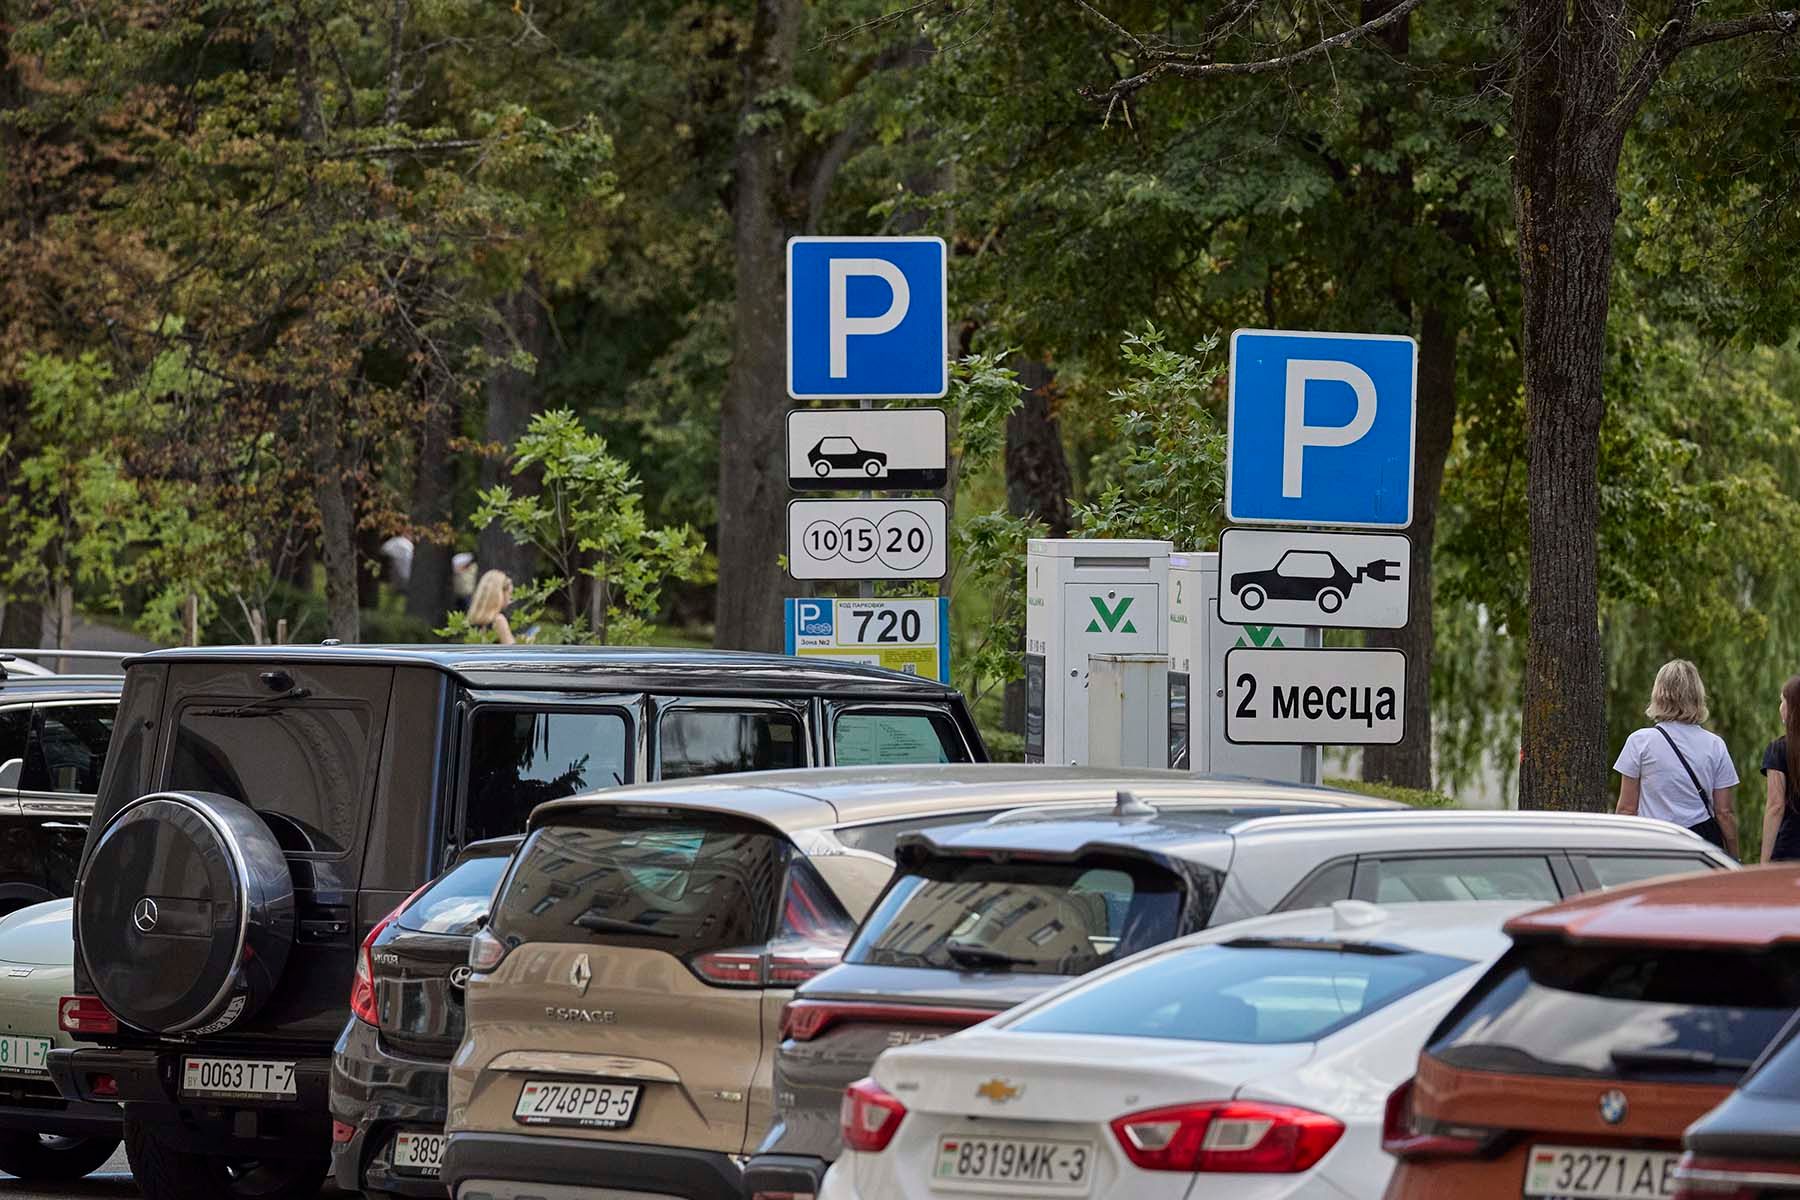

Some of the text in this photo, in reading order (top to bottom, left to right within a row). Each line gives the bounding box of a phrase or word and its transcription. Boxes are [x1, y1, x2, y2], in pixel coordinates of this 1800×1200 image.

[829, 258, 911, 379] P
[1282, 358, 1378, 498] P
[811, 527, 925, 553] 10 15 20
[1176, 580, 1182, 604] 2
[799, 604, 820, 632] P
[852, 609, 921, 643] 720
[1235, 672, 1397, 729] 2 месца
[545, 1007, 616, 1024] ESPACE
[201, 1062, 296, 1091] 0063TT-7
[534, 1085, 634, 1116] 2748PB-5
[958, 1141, 1086, 1182] 8319MK-3
